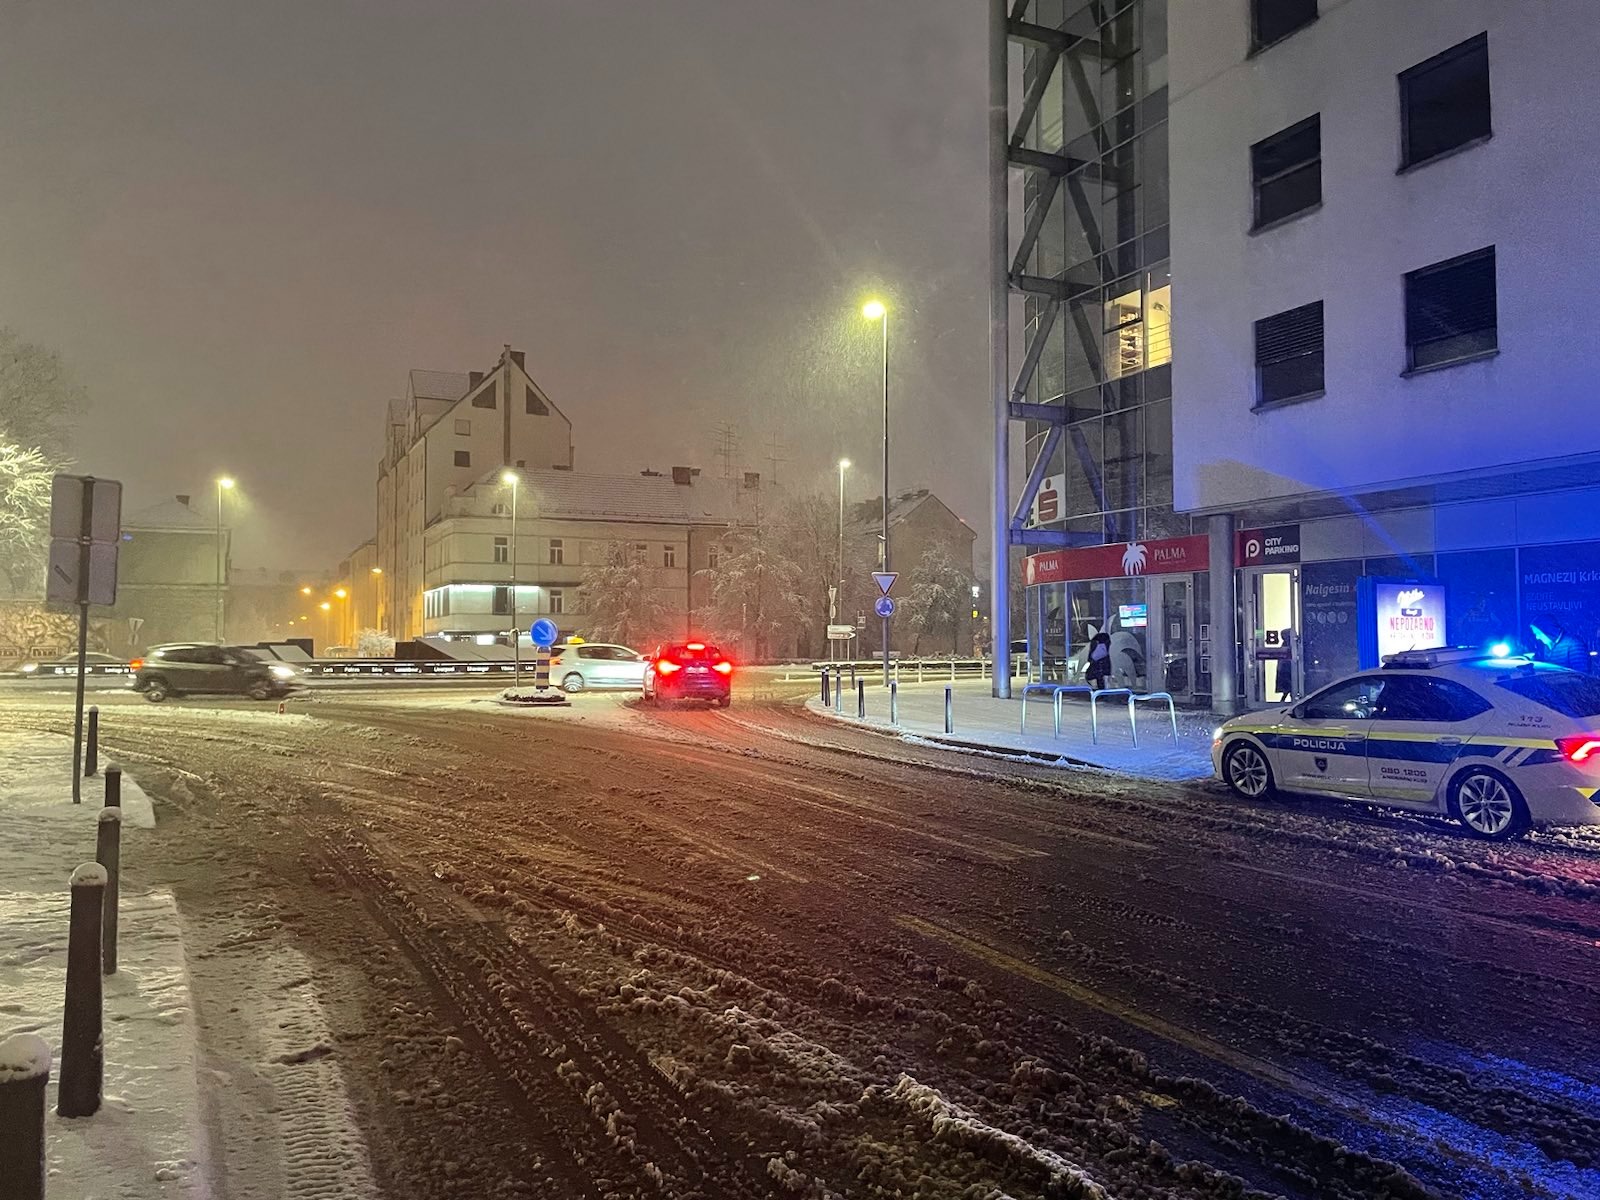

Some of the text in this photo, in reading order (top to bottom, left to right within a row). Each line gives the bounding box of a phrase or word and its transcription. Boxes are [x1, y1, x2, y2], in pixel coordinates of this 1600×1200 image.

[1264, 537, 1283, 546] CITY
[1154, 547, 1187, 561] PALMA
[1264, 545, 1300, 556] PARKING
[1039, 560, 1059, 572] PALMA
[1524, 571, 1577, 584] MAGNEZIJ
[1305, 582, 1350, 598] Nalgesin
[1390, 617, 1434, 631] NEPOZABNO
[1293, 738, 1347, 751] POLICIJA
[1403, 768, 1428, 777] 1200
